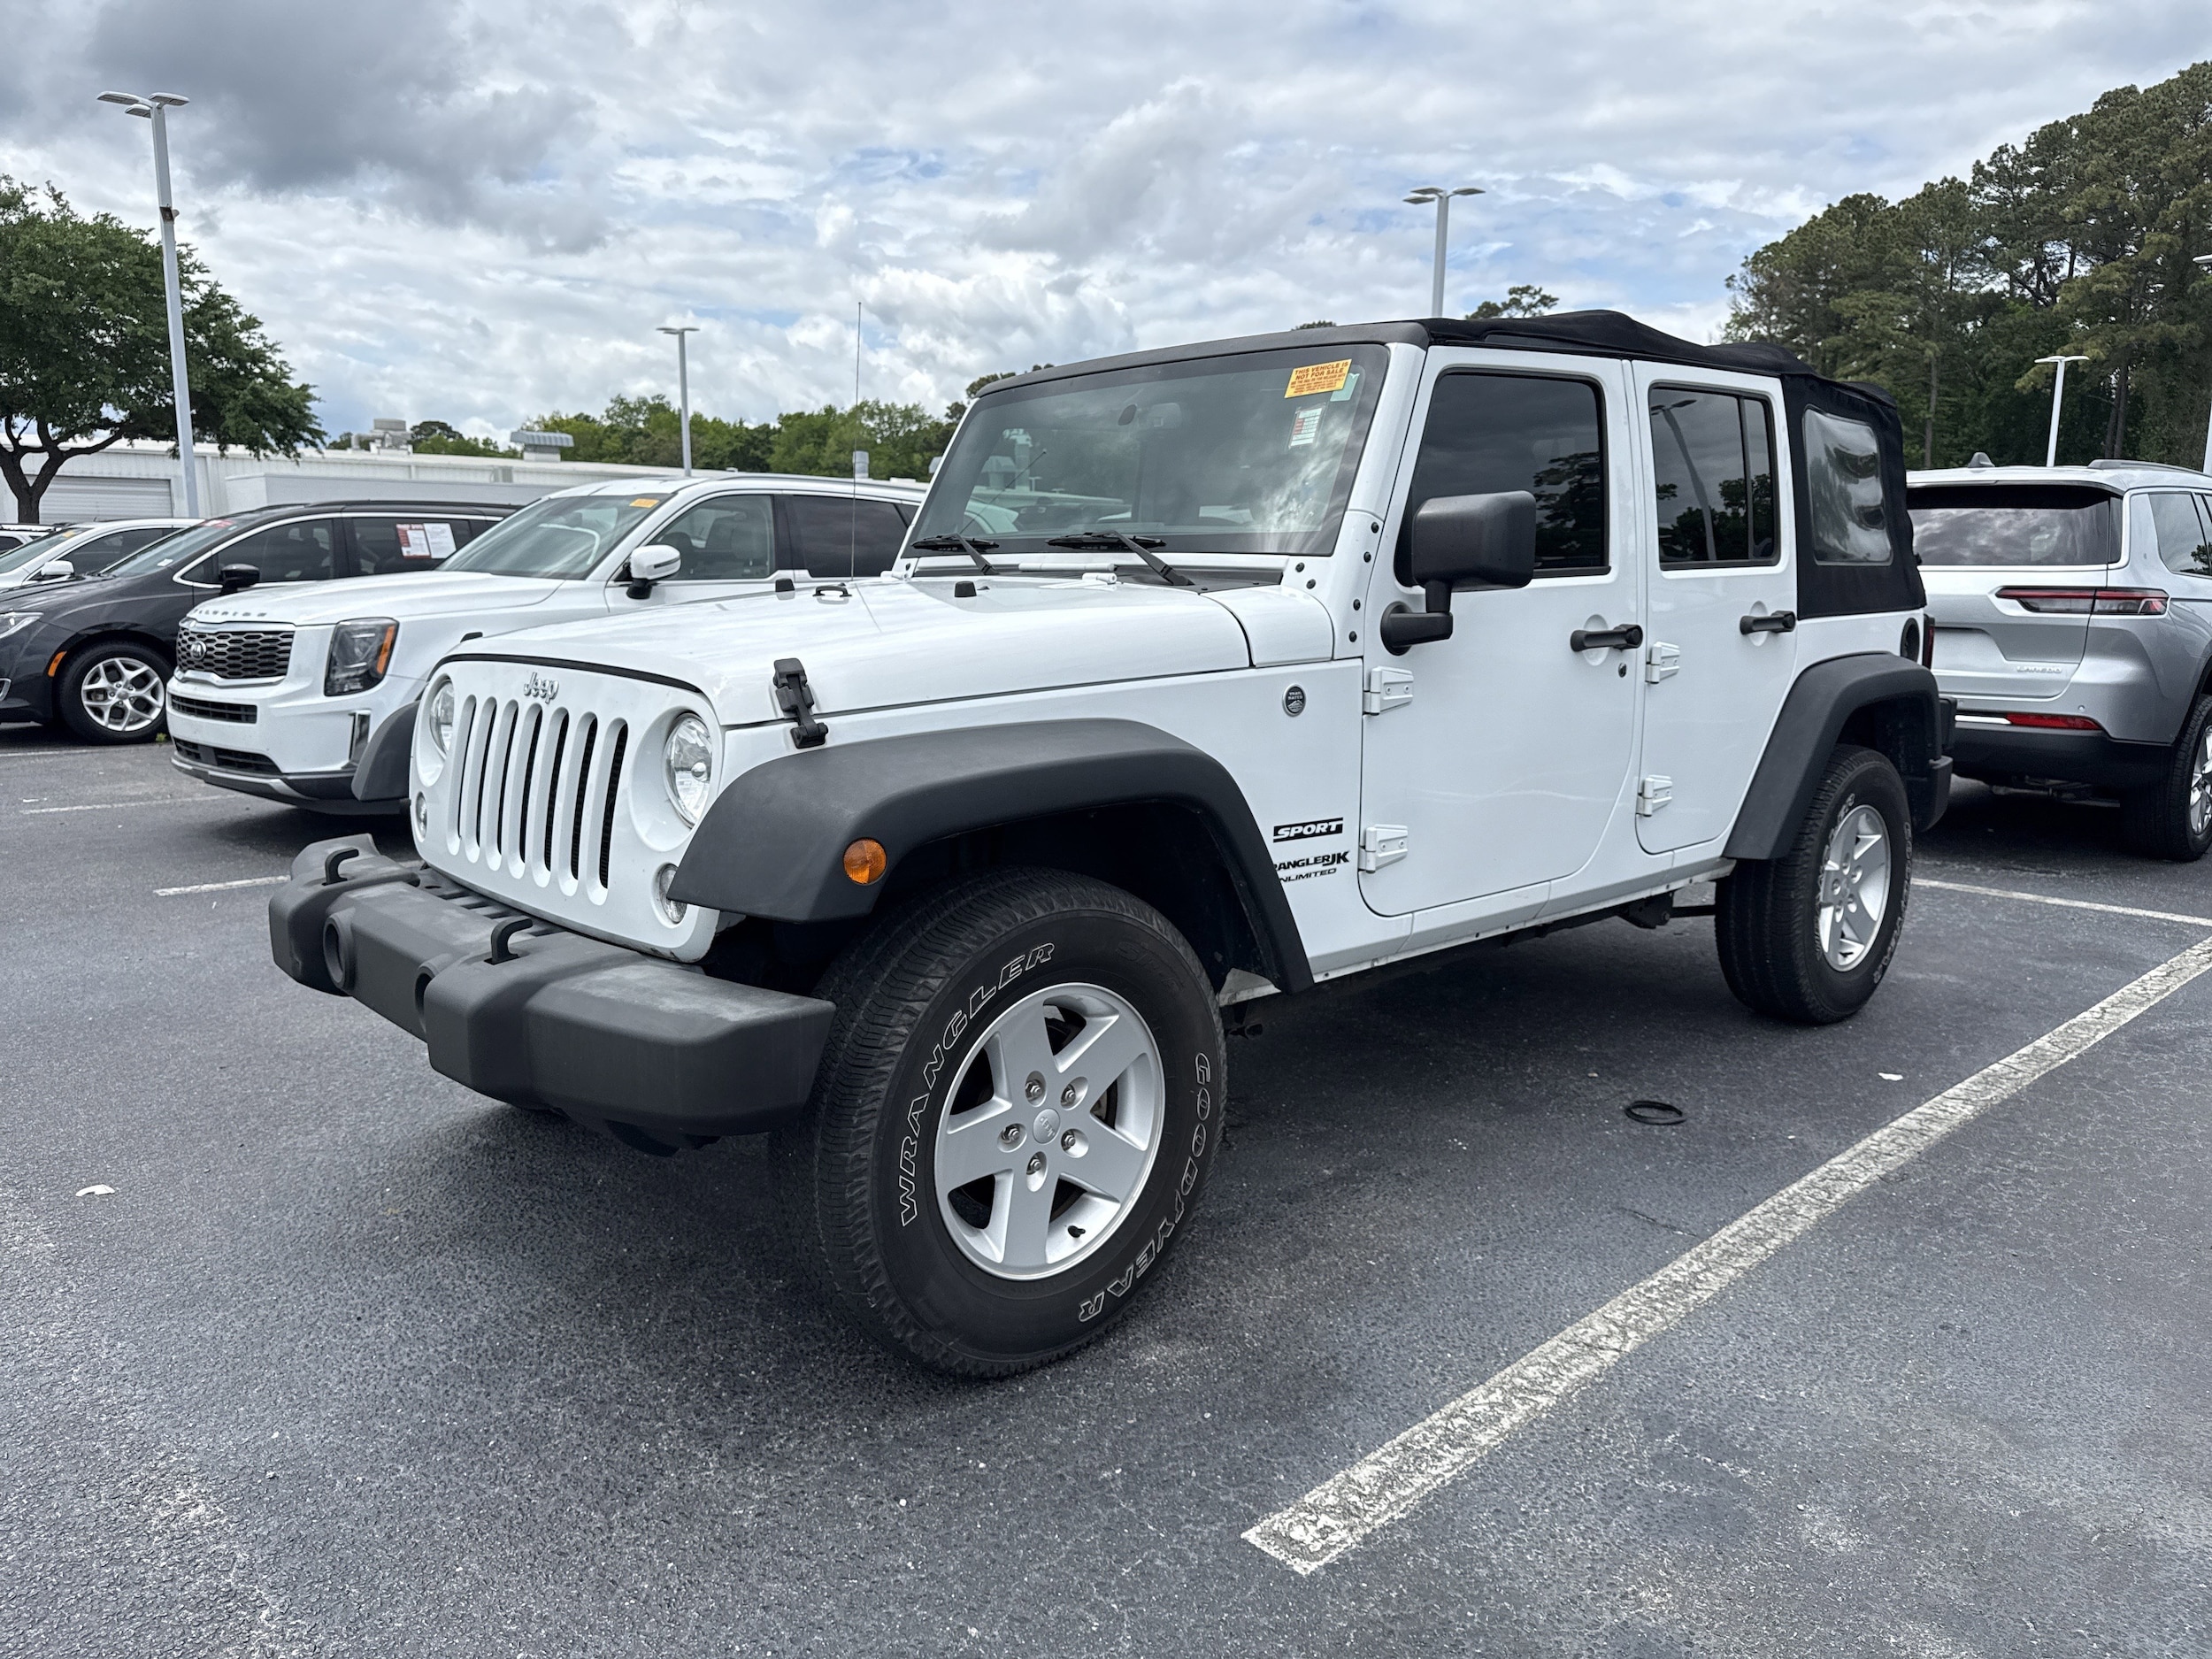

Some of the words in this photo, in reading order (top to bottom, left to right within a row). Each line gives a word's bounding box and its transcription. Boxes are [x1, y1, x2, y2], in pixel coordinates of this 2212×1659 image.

[1311, 363, 1340, 373] VEHICLE
[523, 672, 559, 704] Jeep
[1274, 820, 1343, 840] SPORT
[1279, 867, 1337, 882] NLIMITED
[899, 942, 1056, 1226] WRANGLER
[1078, 1052, 1211, 1323] GOODYEAR
